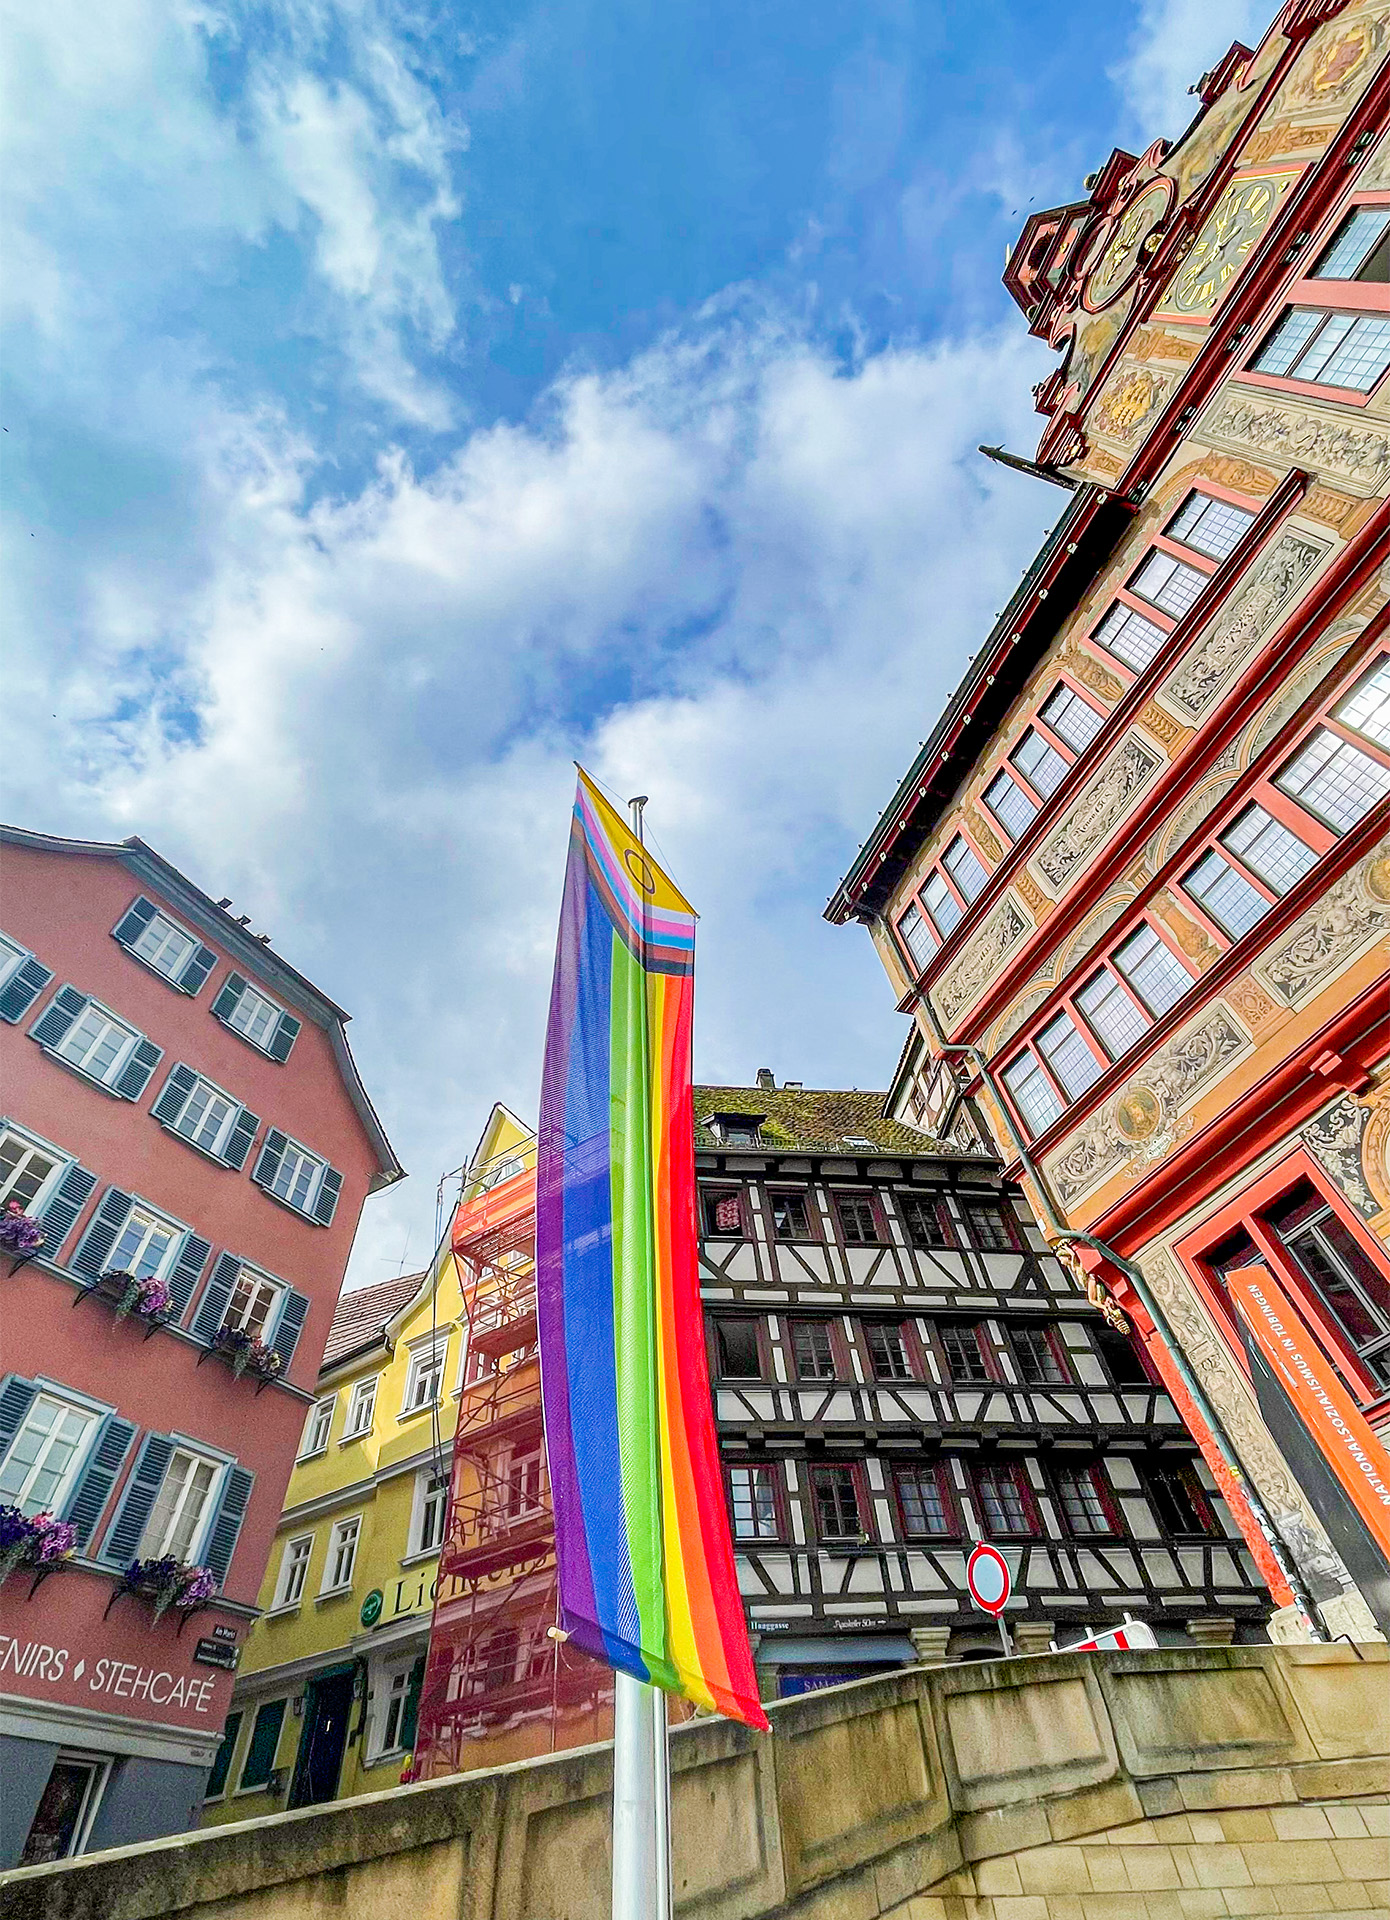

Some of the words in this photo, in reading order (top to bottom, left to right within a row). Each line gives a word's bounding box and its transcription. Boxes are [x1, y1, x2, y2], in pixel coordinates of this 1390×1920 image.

[1247, 1284, 1287, 1338] TÜBINGEN
[1281, 1338, 1296, 1352] IN
[1290, 1353, 1390, 1506] NATIONALSOZIALISMUS
[90, 1658, 215, 1713] STEHCAFÉ
